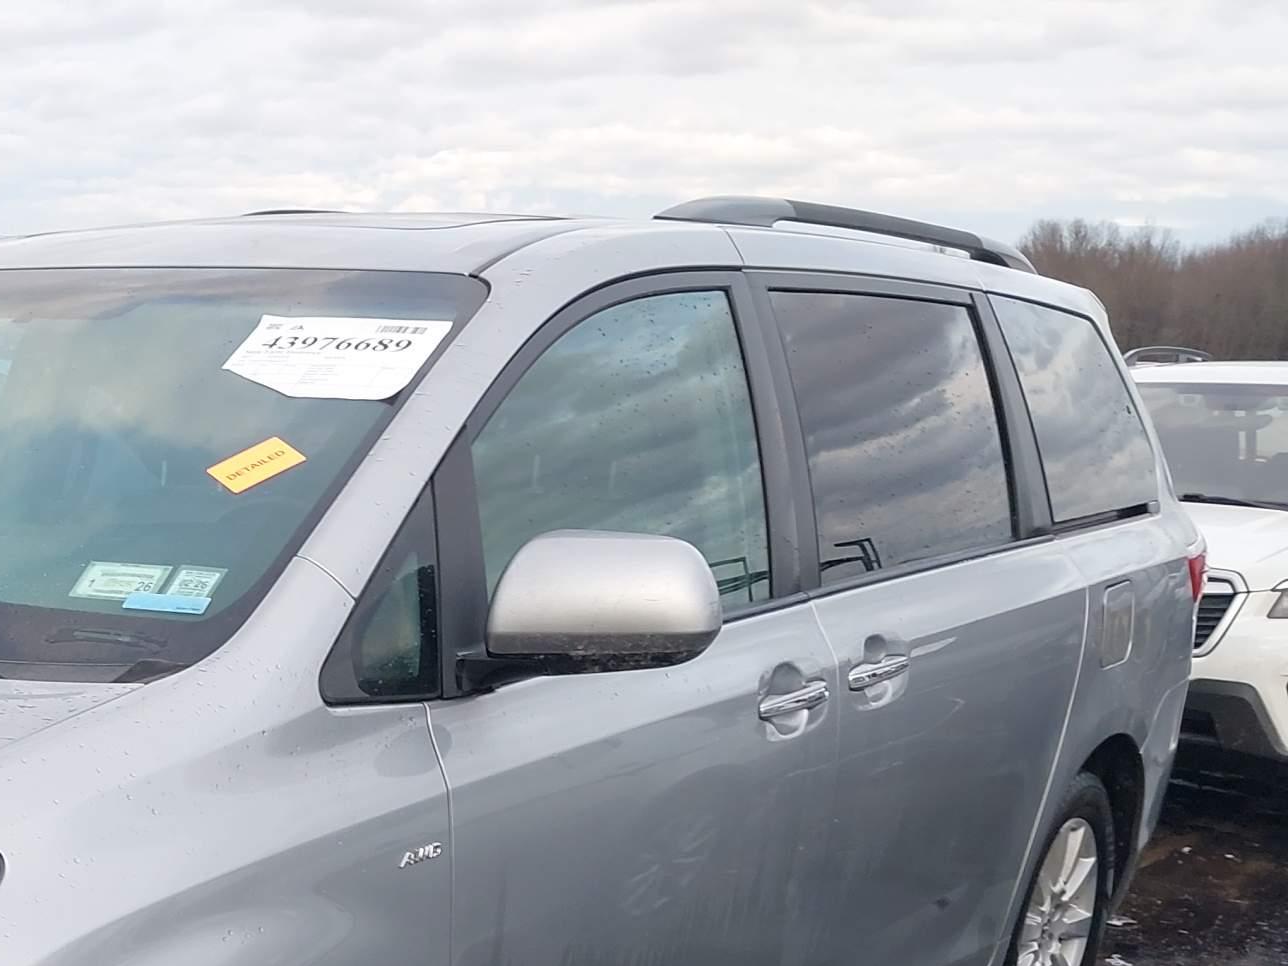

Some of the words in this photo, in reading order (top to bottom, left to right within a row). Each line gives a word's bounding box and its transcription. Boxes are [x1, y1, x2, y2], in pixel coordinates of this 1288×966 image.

[261, 335, 413, 352] 43976689
[225, 449, 286, 481] DETAILED
[134, 581, 154, 592] 26
